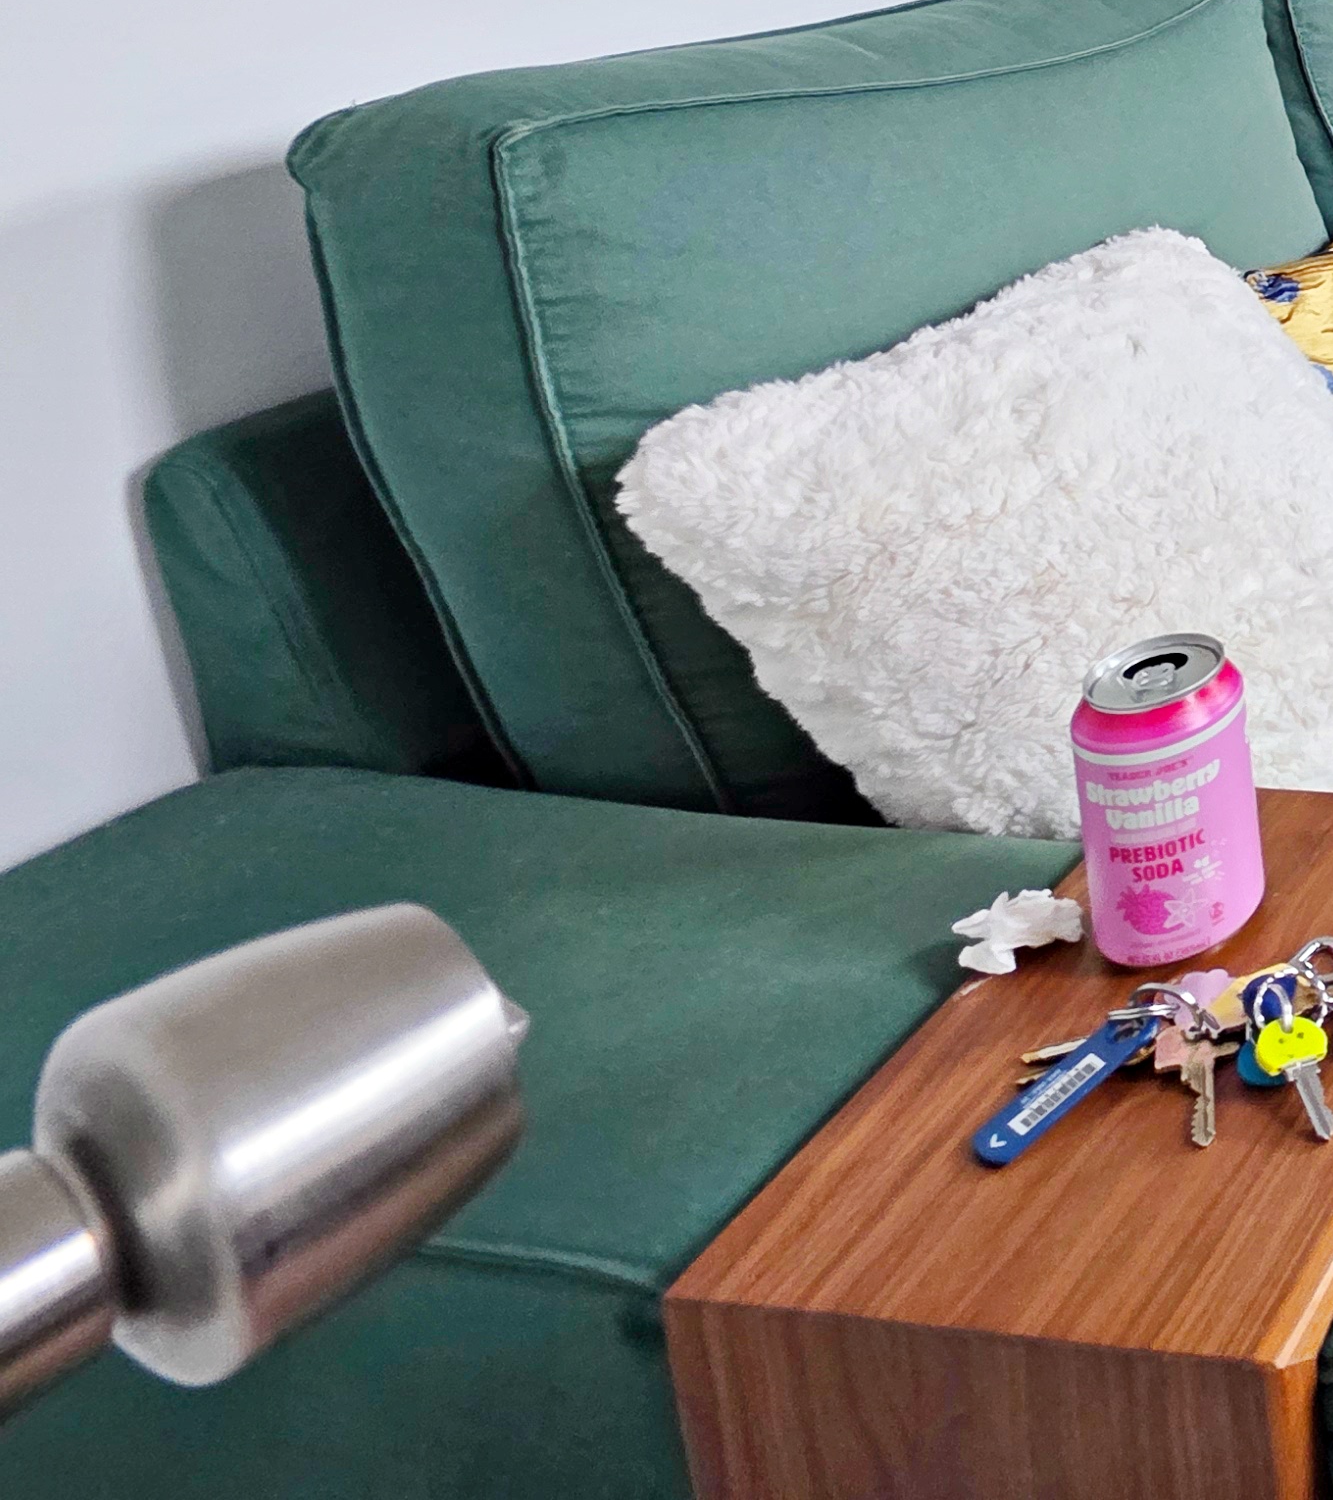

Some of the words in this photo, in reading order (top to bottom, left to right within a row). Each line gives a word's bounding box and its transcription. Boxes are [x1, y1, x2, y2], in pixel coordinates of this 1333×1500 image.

[1085, 758, 1221, 807] Strawberry
[1104, 794, 1200, 831] Vanilla
[1108, 827, 1206, 864] PREBIOTIC
[1131, 858, 1185, 883] SODA
